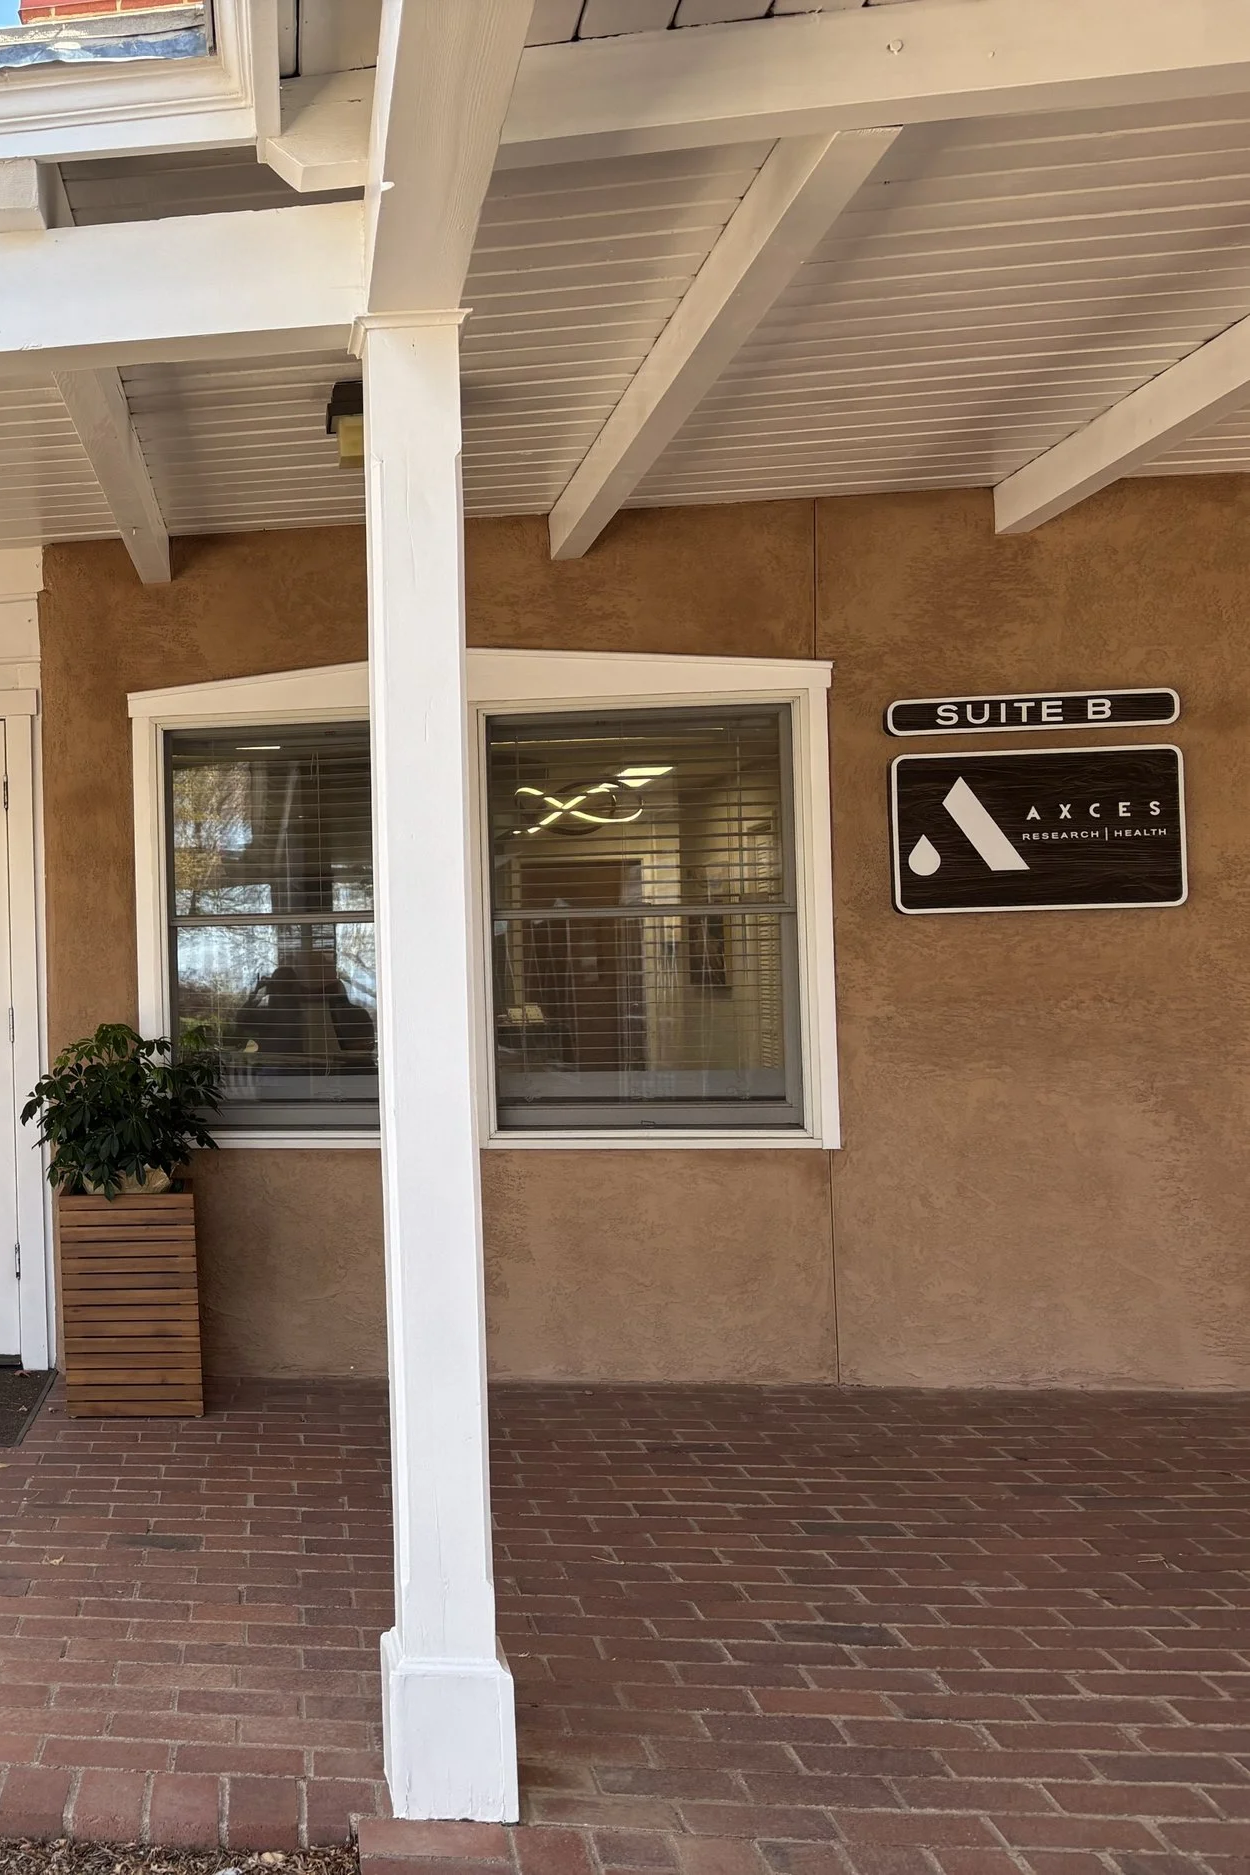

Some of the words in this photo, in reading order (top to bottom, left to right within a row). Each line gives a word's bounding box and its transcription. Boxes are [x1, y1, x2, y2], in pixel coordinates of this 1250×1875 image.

[935, 700, 1064, 726] SUITE
[1087, 698, 1112, 720] B
[1026, 800, 1161, 821] AXCES
[1022, 830, 1099, 841] RESEARCH
[1114, 827, 1167, 837] HEALTH
